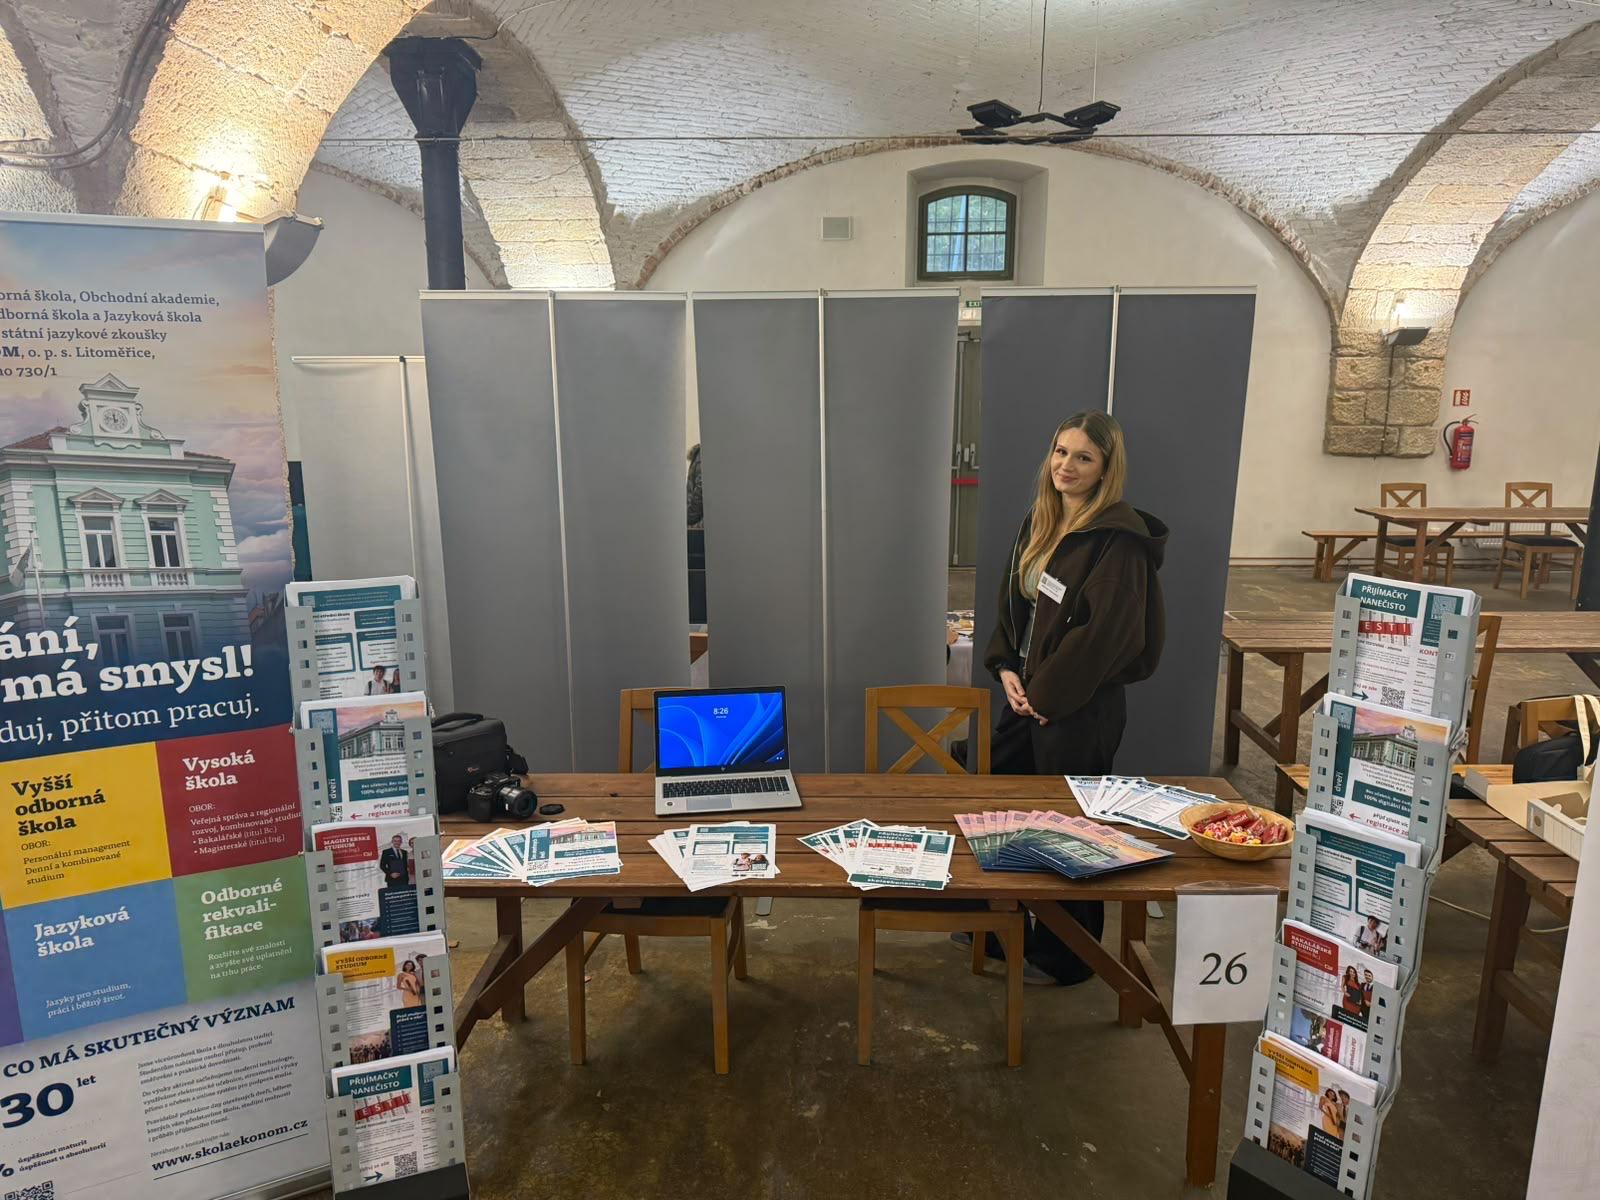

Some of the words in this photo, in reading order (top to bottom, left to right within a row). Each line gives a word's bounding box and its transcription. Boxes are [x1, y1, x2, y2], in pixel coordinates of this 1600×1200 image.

[34, 290, 76, 304] škola,
[80, 290, 148, 303] Obchodní
[151, 292, 220, 306] akademie,
[52, 309, 89, 321] škola
[92, 312, 101, 321] a
[104, 310, 164, 324] Jazyková
[167, 311, 202, 322] škola
[2, 327, 44, 339] státní
[47, 327, 108, 342] jazykové
[112, 328, 167, 342] zkoušky
[0, 346, 24, 359] M,
[28, 349, 40, 358] o.
[44, 348, 57, 360] p.
[61, 349, 72, 358] s.
[76, 346, 155, 360] Litoměřice,
[16, 364, 57, 378] 730/1
[1362, 586, 1408, 600] PŘIJÍMAČKY
[1360, 596, 1406, 612] NANEČISTO
[0, 660, 87, 703] má
[99, 644, 254, 694] smysl!
[0, 717, 53, 745] duj,
[61, 708, 160, 741] přitom
[167, 693, 260, 727] pracuj.
[182, 750, 256, 774] Vysoká
[12, 774, 74, 798] Vyšší
[185, 772, 238, 790] škola
[15, 788, 106, 816] odborná
[188, 803, 216, 813] OBOR:
[190, 816, 221, 826] Veřejná
[222, 811, 248, 822] správa
[256, 802, 296, 816] regionální
[18, 816, 76, 836] škola
[192, 826, 219, 836] rozvoj,
[220, 817, 274, 832] kombinované
[21, 840, 52, 850] OBOR:
[198, 832, 242, 844] Bakalářské
[200, 841, 248, 854] Magisterské
[24, 850, 72, 865] Personální
[74, 840, 130, 855] management
[25, 863, 55, 875] Denní
[62, 852, 122, 868] kombinované
[26, 872, 65, 885] studium
[201, 878, 282, 904] Odborné
[202, 898, 276, 922] rekvali-
[34, 906, 130, 941] Jazyková
[204, 921, 263, 940] fikace
[38, 936, 94, 957] škola
[256, 940, 286, 951] znalosti
[1199, 952, 1247, 985] 26
[46, 994, 75, 1008] Jazyky
[76, 990, 92, 1000] pro
[92, 982, 132, 996] studium,
[48, 1006, 70, 1018] práci
[76, 998, 102, 1010] běžný
[3, 1058, 35, 1078] CO
[40, 1044, 80, 1070] MÁ
[84, 1016, 200, 1058] SKUTEČNÝ
[204, 996, 296, 1028] VÝZNAM
[350, 1071, 399, 1086] PŘIJÍMAČKY
[350, 1081, 400, 1096] NANEČISTO
[0, 1082, 74, 1128] 30
[76, 1075, 96, 1088] let
[18, 1148, 57, 1164] úspěšnost
[58, 1140, 88, 1152] maturit
[152, 1119, 308, 1171] www.skolaekonom.cz
[20, 1156, 58, 1172] úspěšnost
